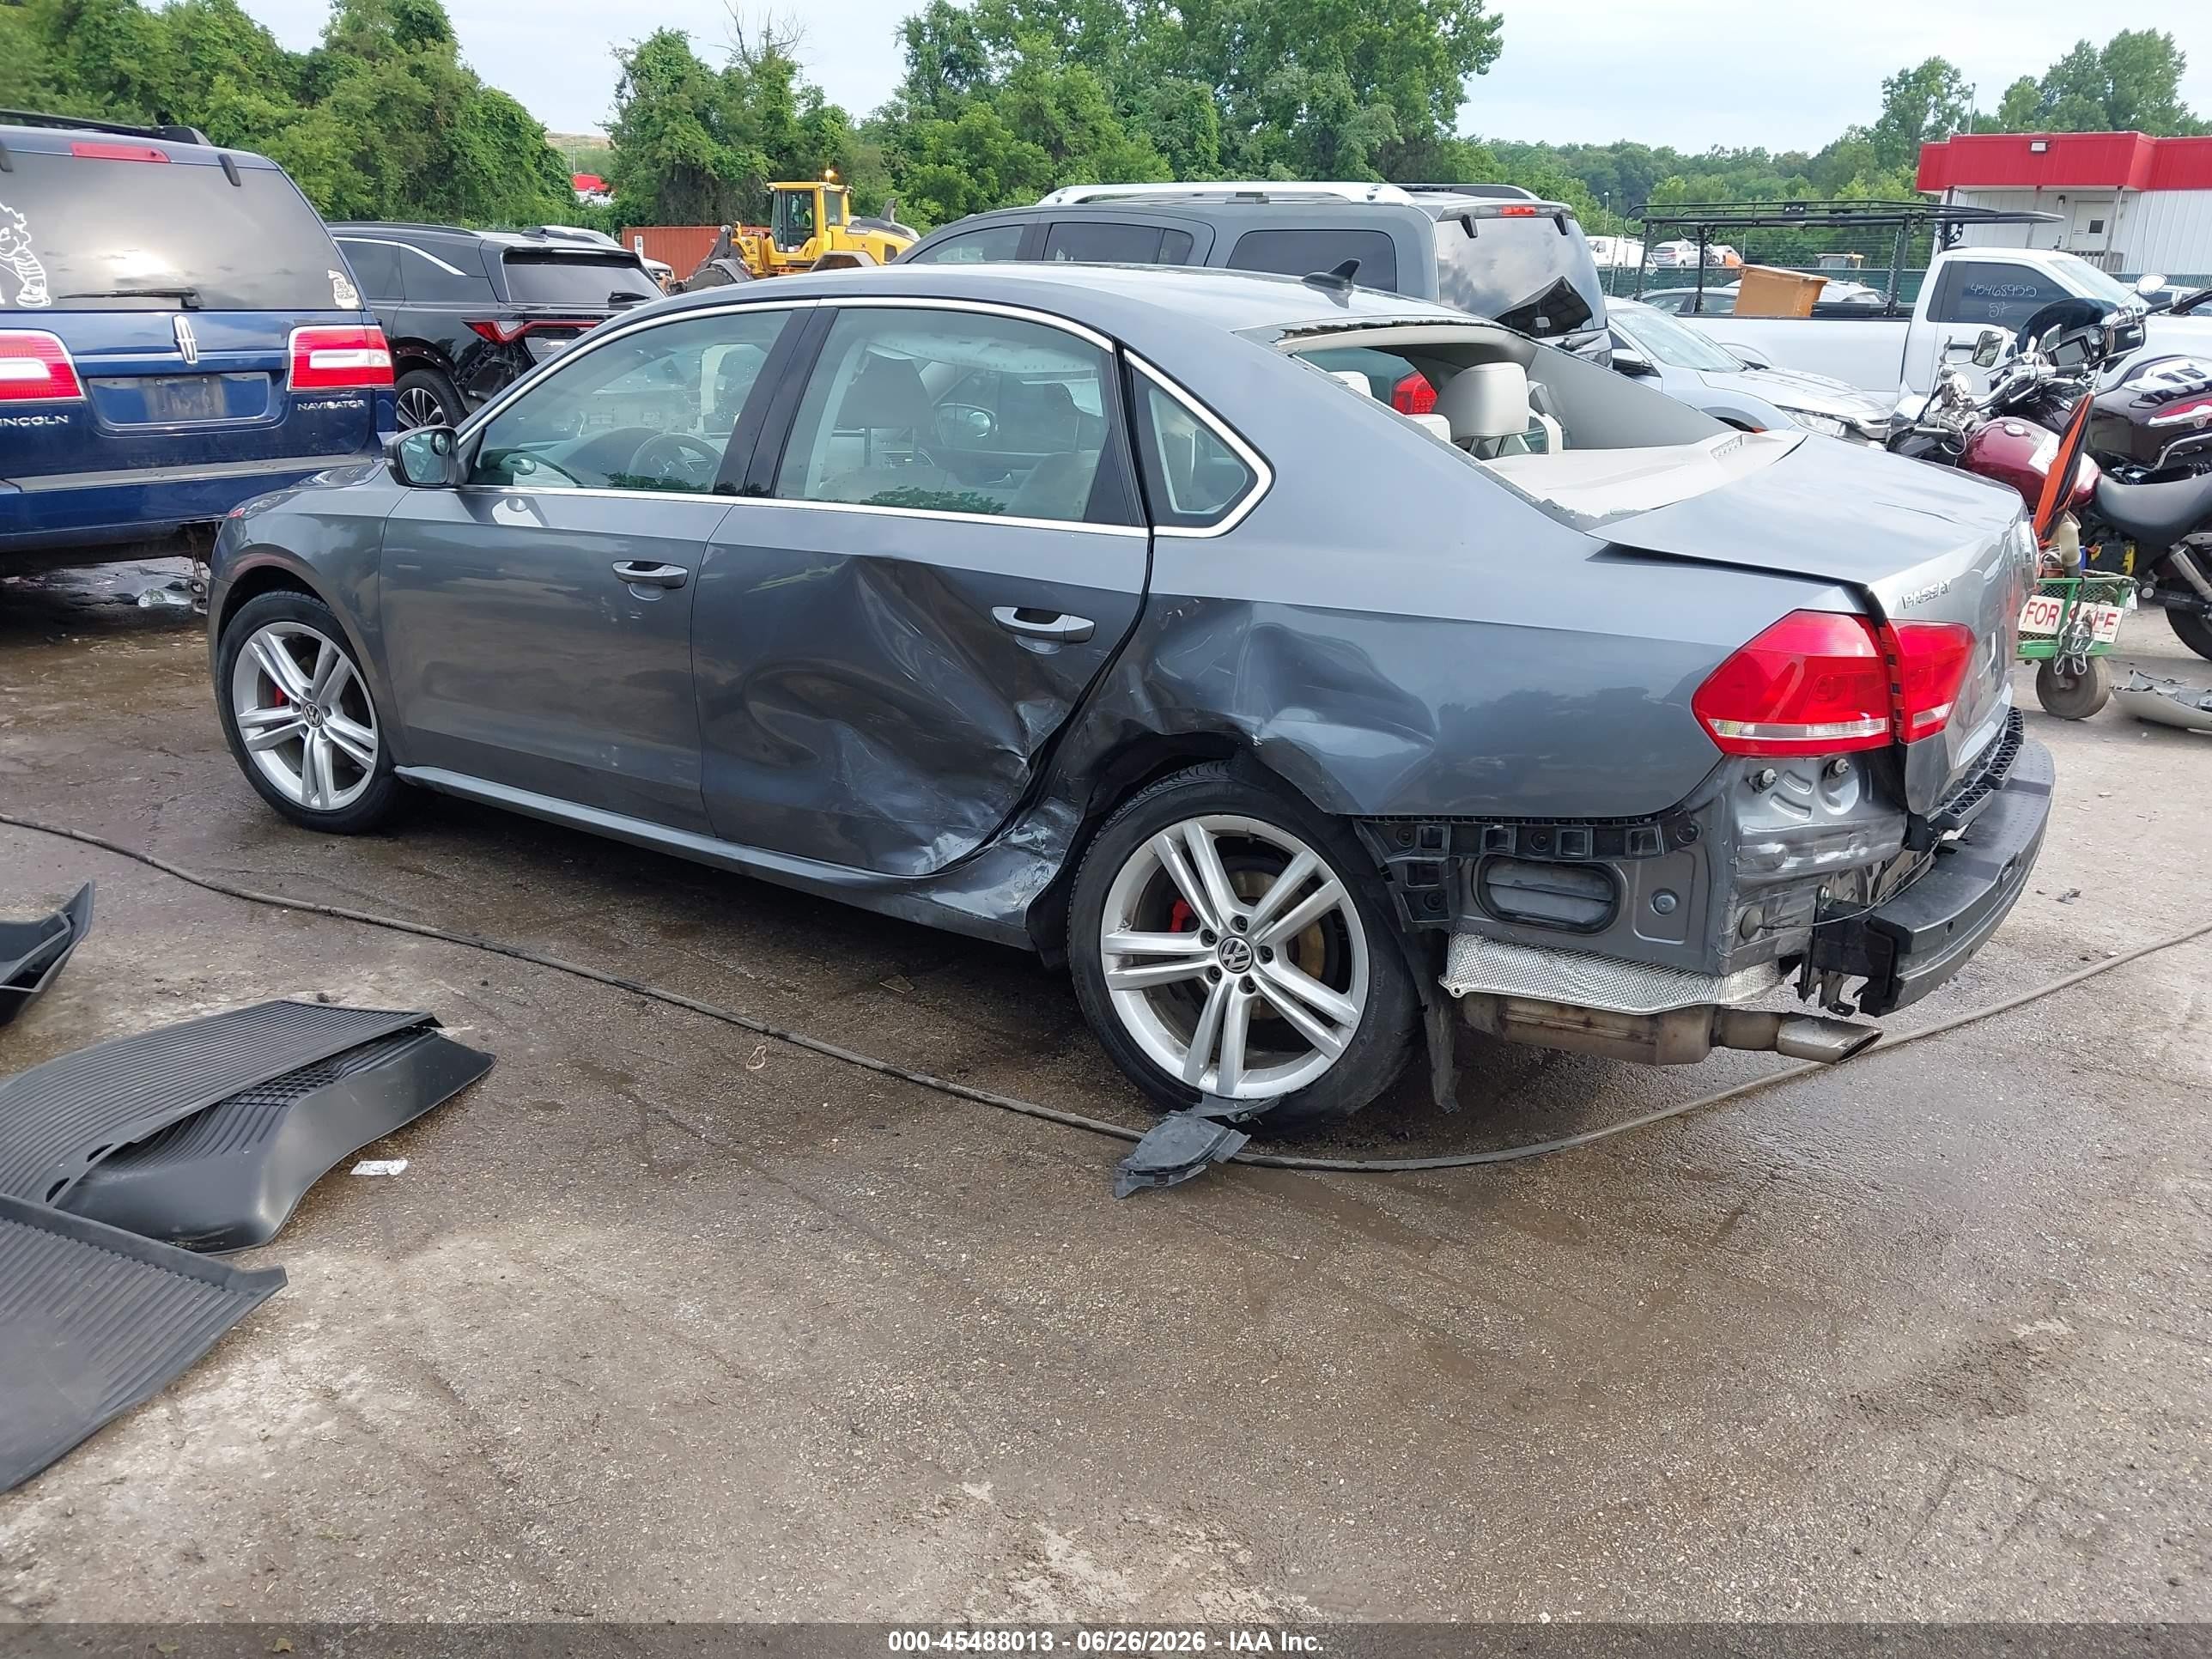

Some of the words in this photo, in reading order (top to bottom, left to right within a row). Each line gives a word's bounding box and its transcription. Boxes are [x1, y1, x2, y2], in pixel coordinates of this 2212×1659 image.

[297, 399, 365, 411] NAVIGATOR
[0, 415, 69, 427] INCOLN
[1900, 579, 1952, 610] PASSAT
[2023, 601, 2060, 628] FOR
[2069, 605, 2118, 635] SLE
